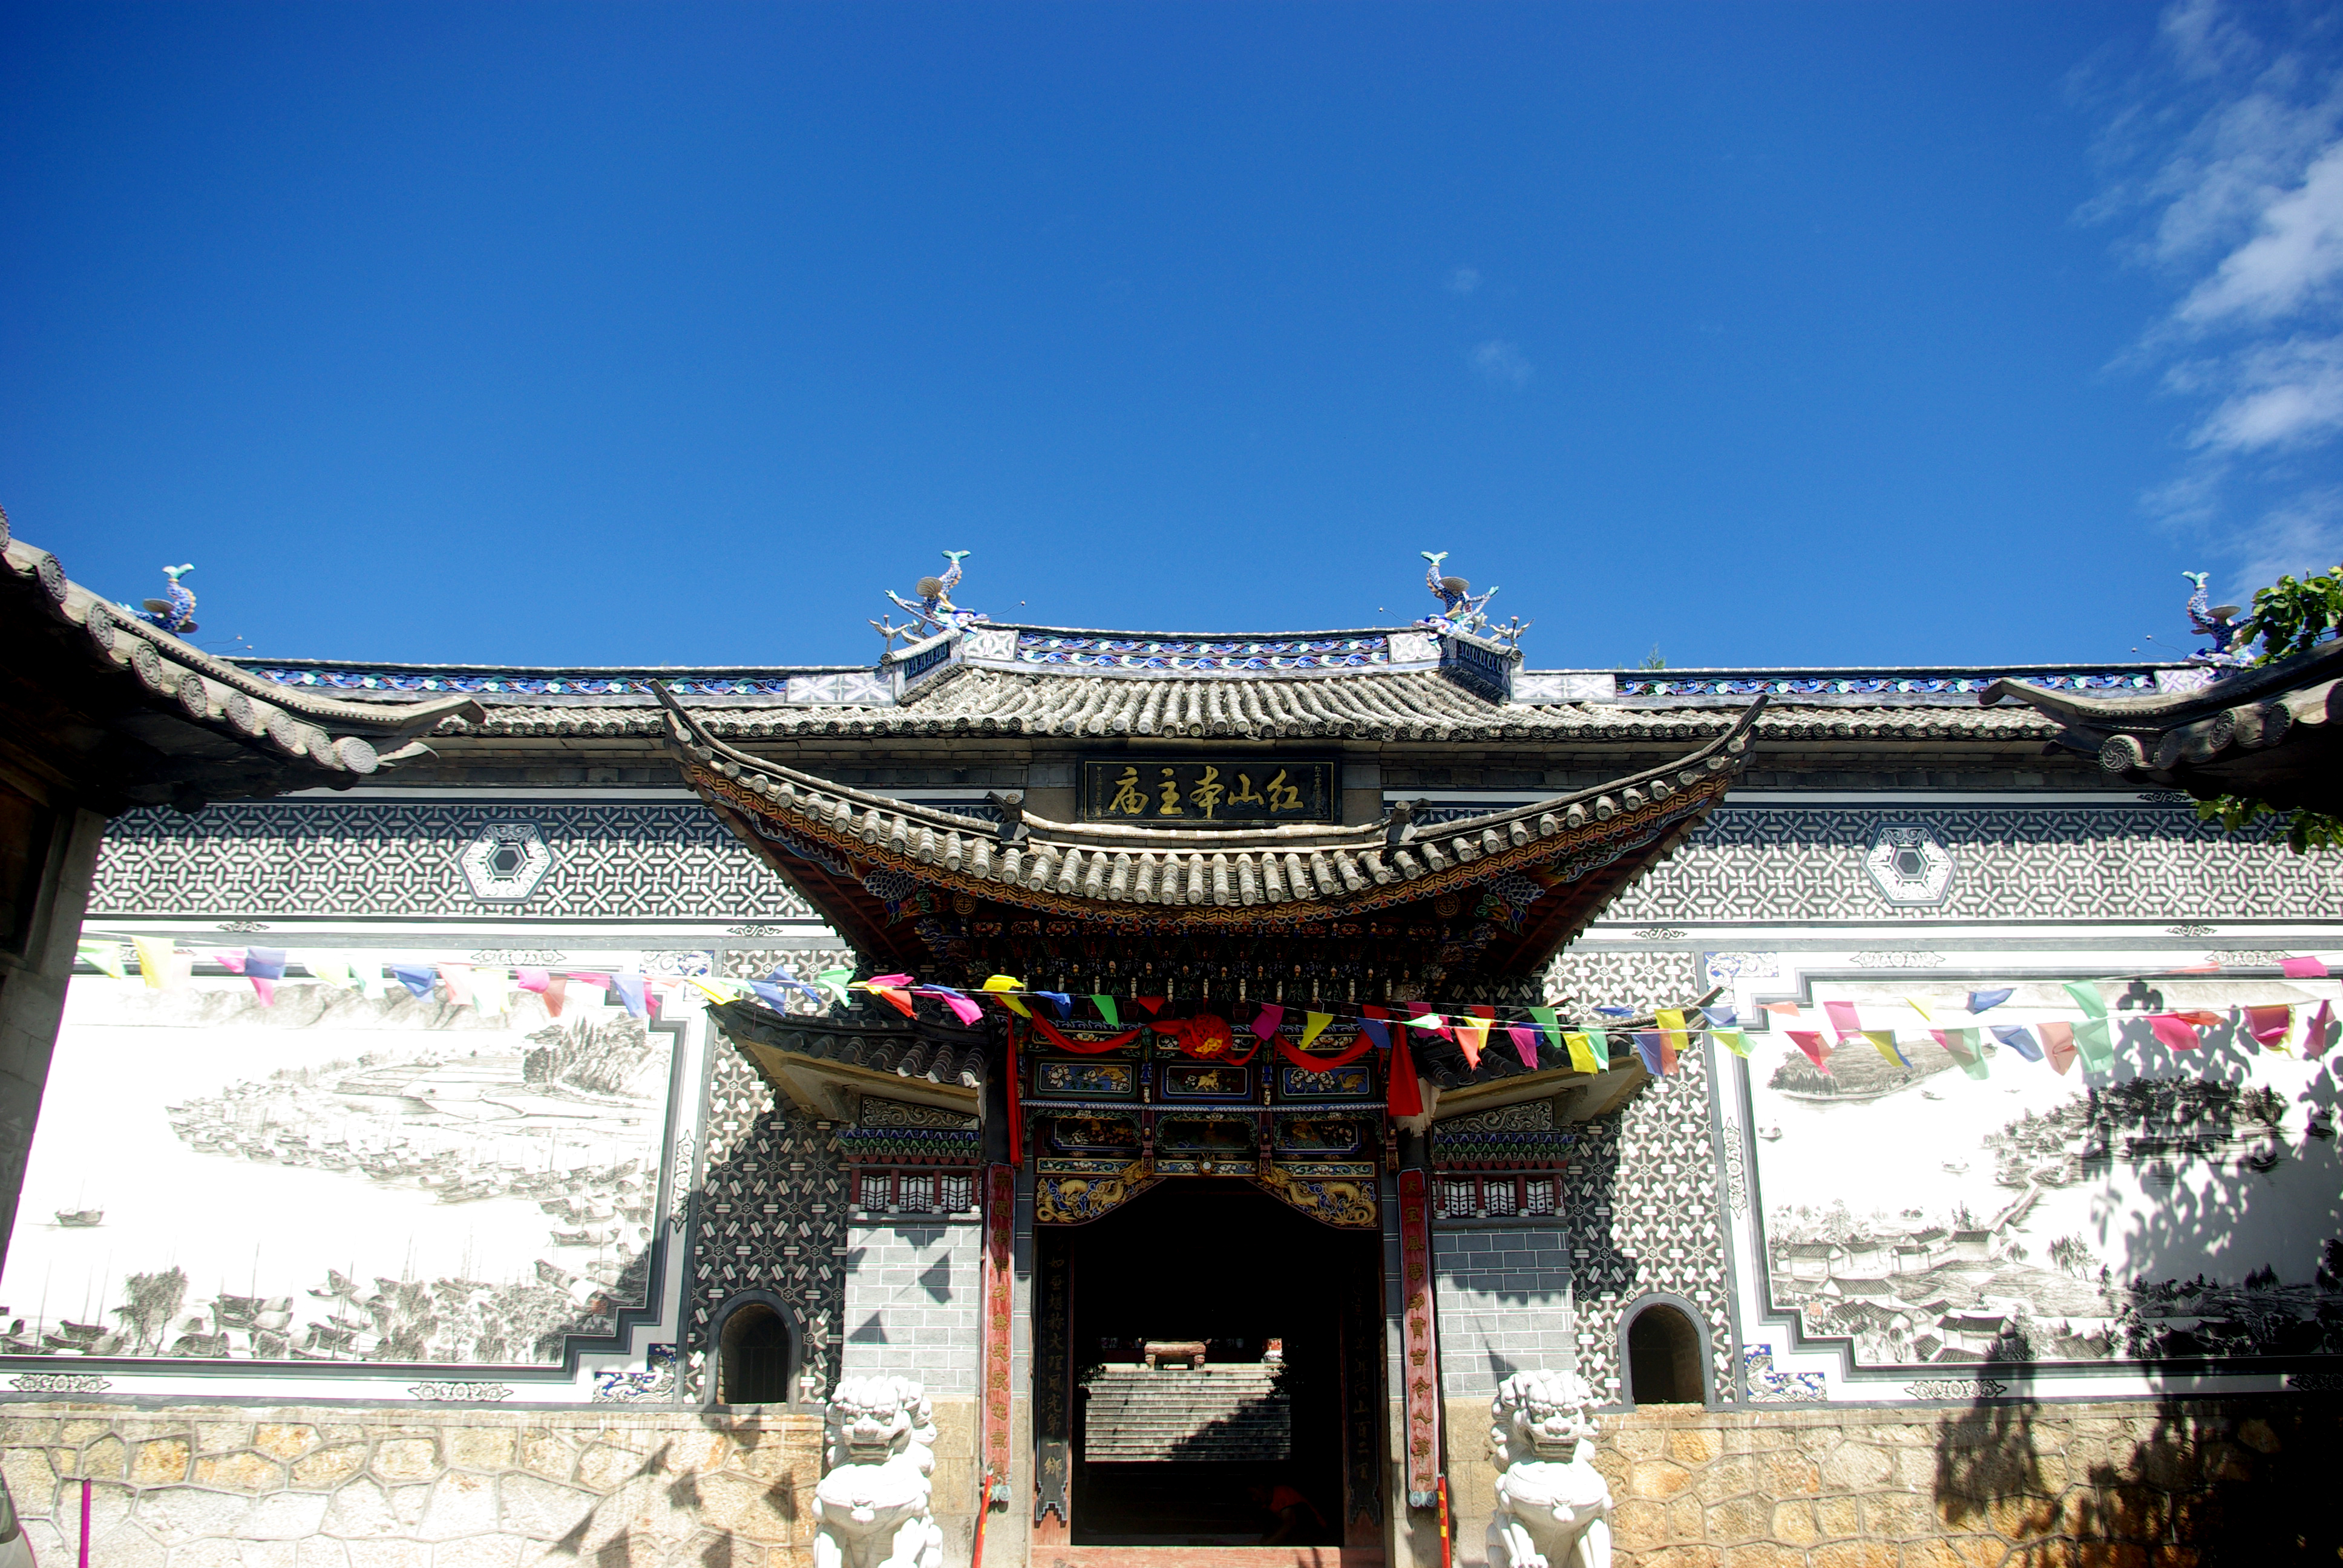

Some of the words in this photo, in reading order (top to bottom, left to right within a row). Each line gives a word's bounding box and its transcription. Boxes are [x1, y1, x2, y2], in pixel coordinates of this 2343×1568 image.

[1109, 765, 1304, 819] 红山本主庙
